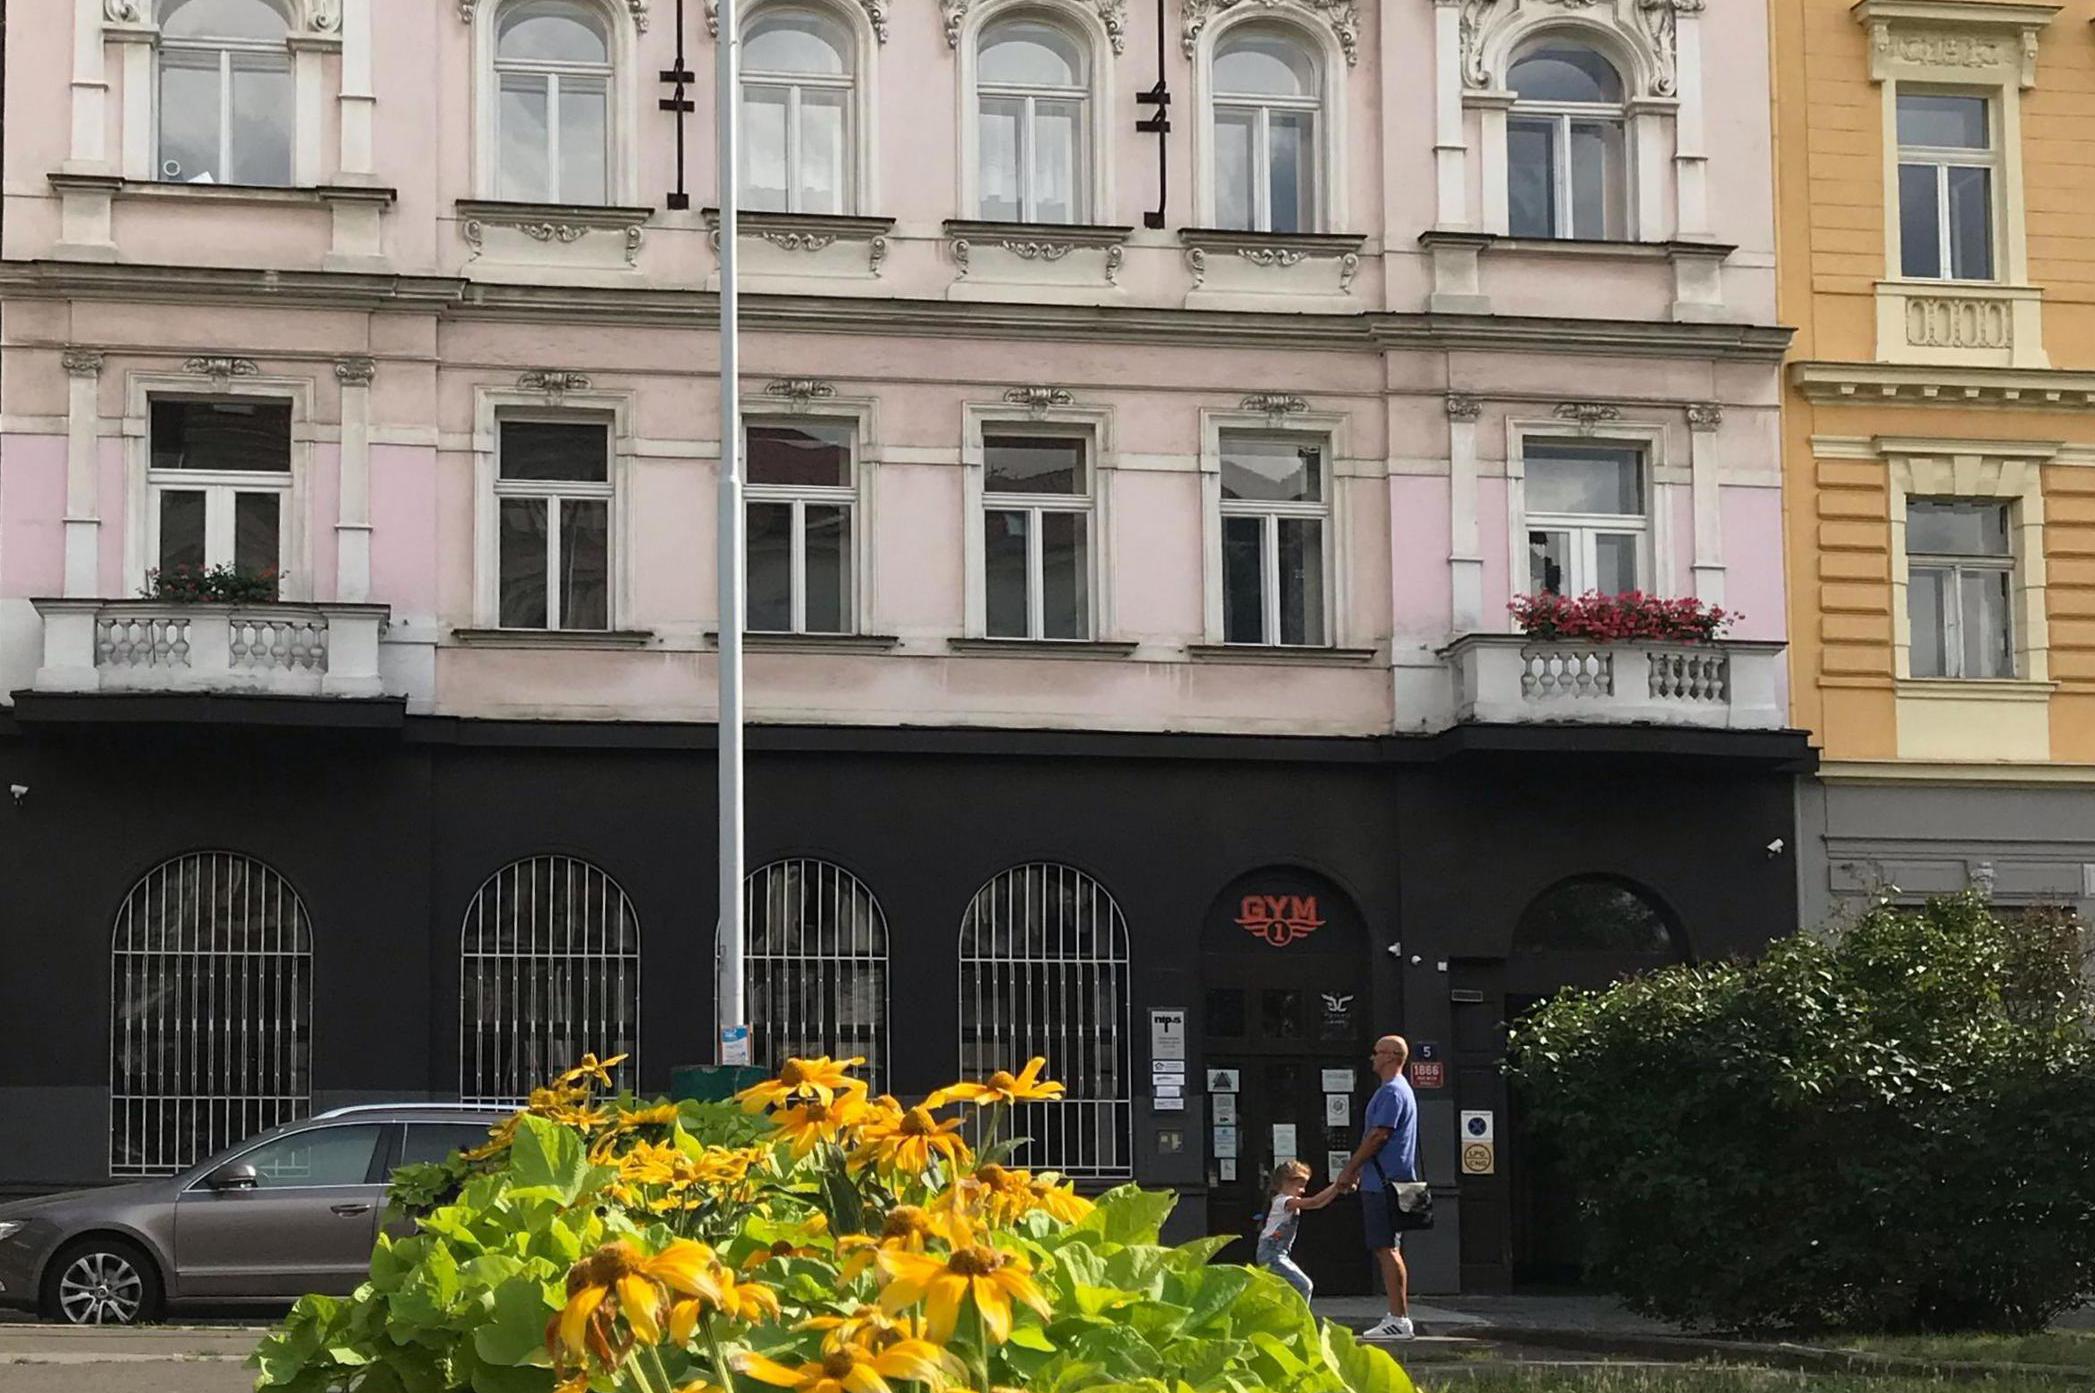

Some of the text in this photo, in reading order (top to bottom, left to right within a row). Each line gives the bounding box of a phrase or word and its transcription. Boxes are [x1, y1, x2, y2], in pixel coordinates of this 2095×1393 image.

[1241, 895, 1317, 922] GYM
[1275, 923, 1285, 941] 1
[1423, 1046, 1432, 1058] 5
